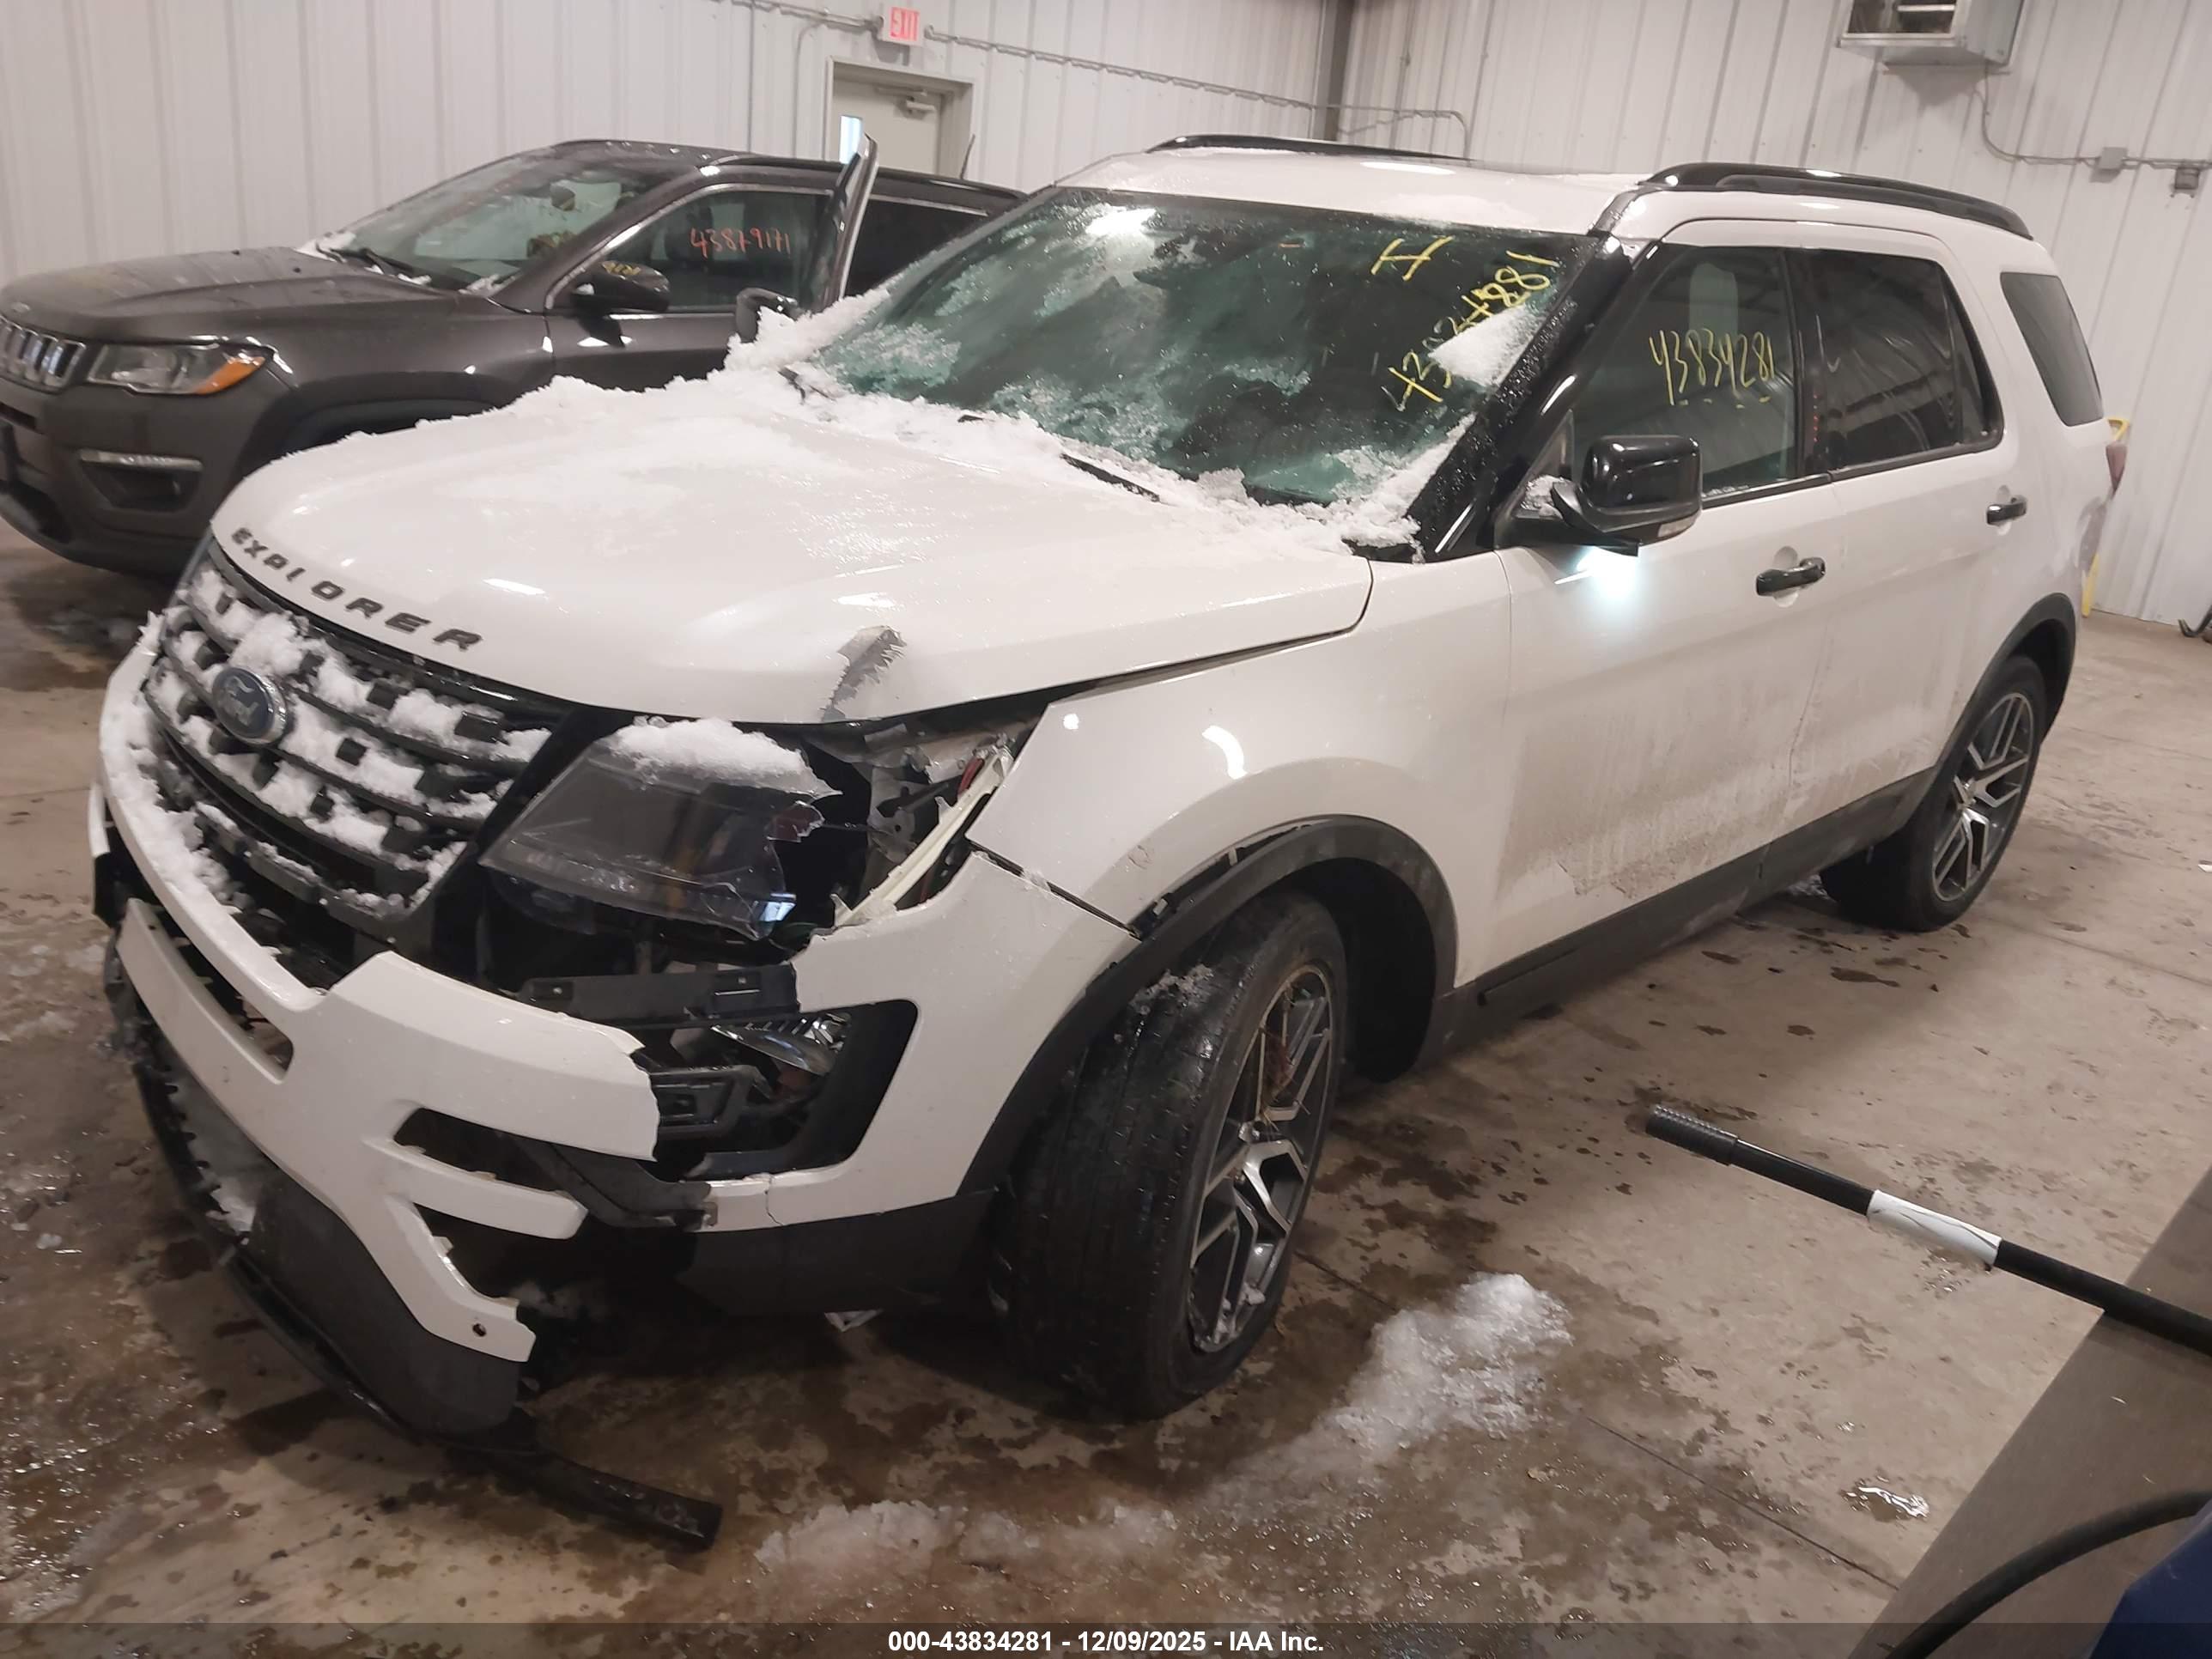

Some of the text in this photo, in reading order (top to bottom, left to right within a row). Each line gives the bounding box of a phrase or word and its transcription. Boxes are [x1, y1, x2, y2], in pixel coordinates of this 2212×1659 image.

[890, 7, 920, 41] EXIT
[1371, 235, 1455, 281] H
[1649, 324, 1775, 406] 43834281
[231, 527, 483, 652] EXPLORER
